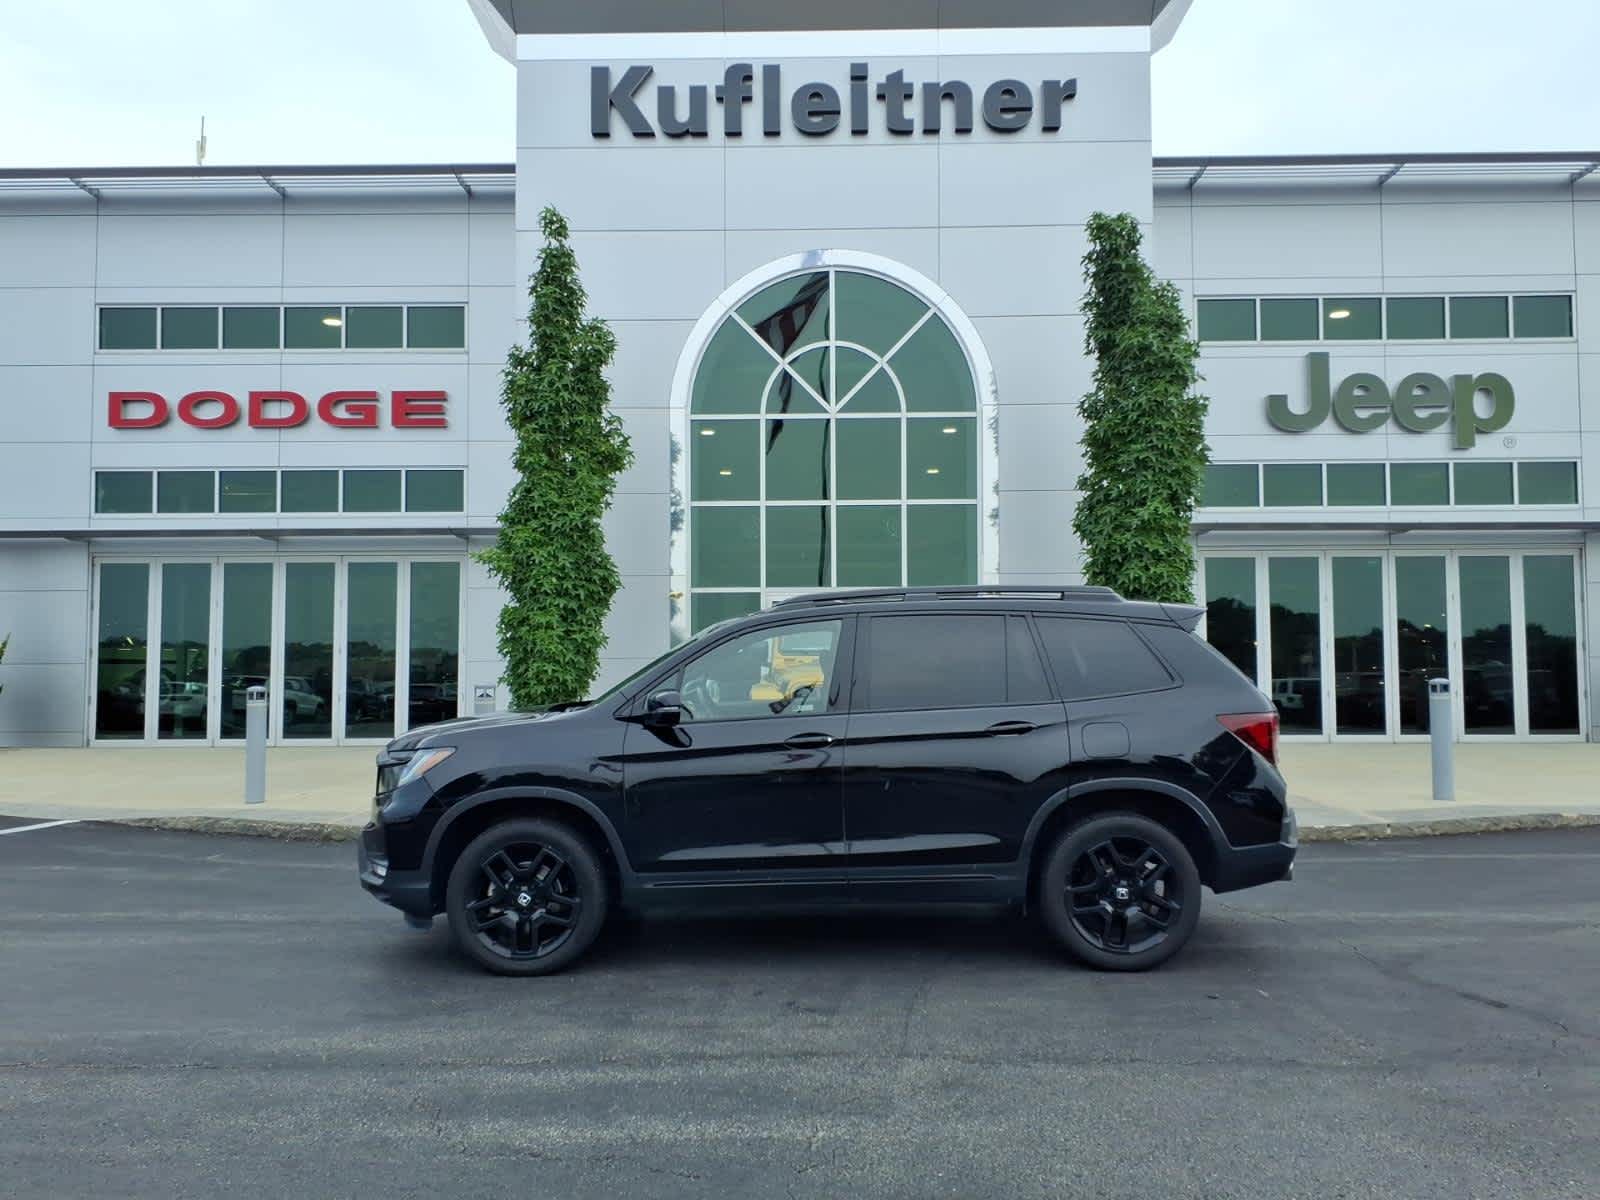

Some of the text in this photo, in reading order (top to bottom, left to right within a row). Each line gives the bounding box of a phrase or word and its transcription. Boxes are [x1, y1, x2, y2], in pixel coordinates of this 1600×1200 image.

[590, 62, 1077, 138] Kufleitner
[108, 390, 448, 429] DODGE
[1265, 351, 1515, 450] Jeep
